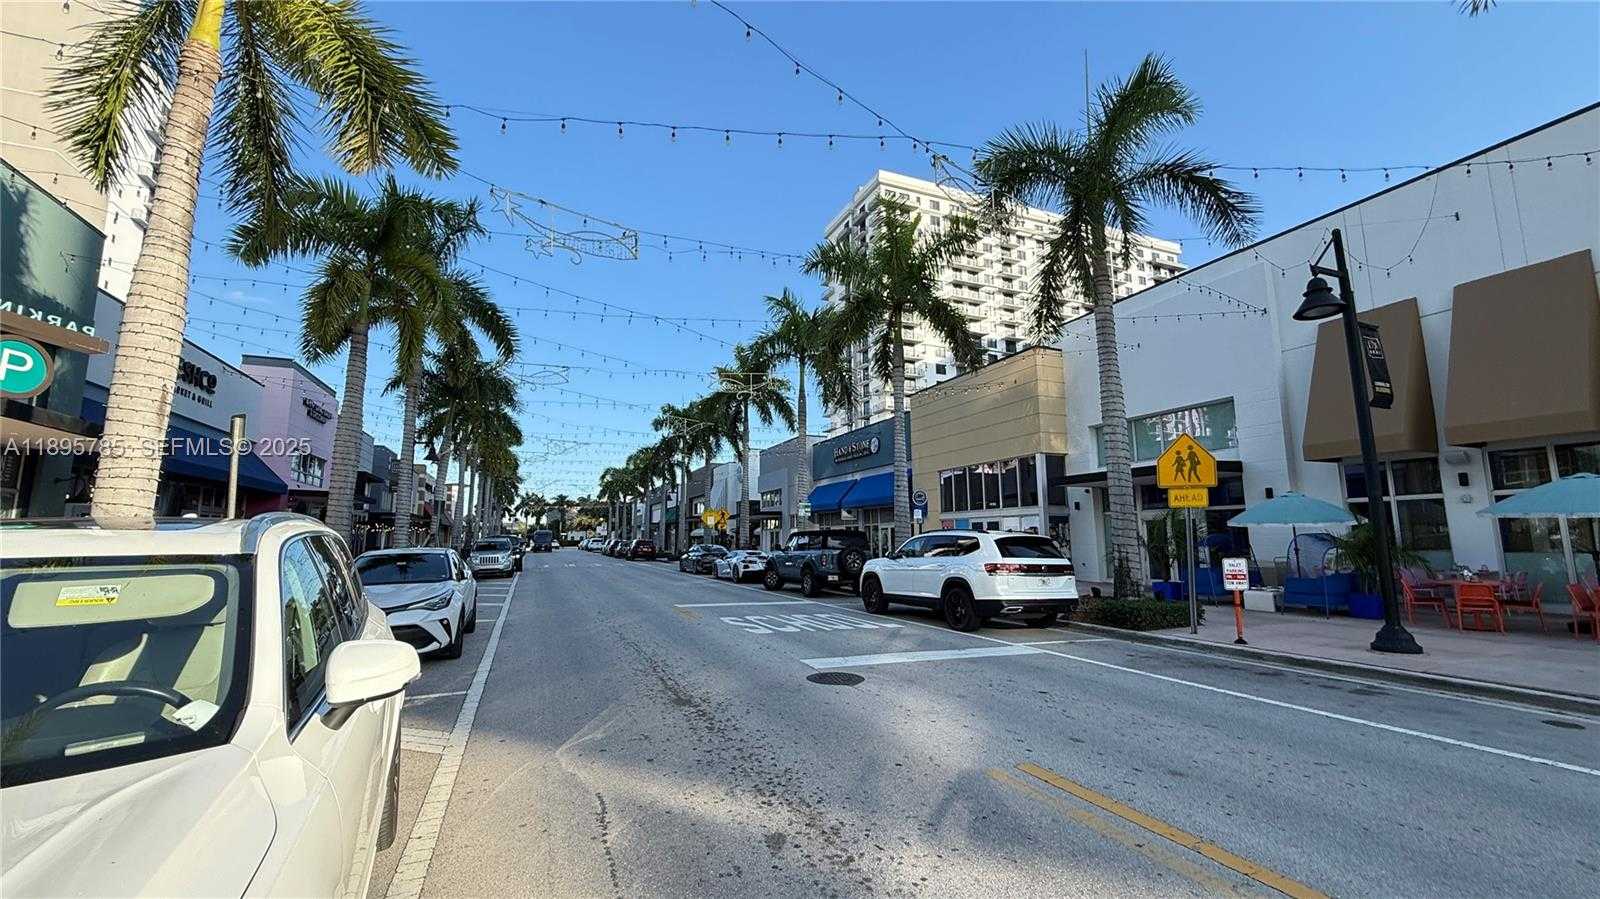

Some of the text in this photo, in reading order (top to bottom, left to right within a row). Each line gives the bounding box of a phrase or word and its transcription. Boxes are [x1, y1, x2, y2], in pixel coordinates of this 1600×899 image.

[0, 347, 34, 381] P
[1173, 492, 1204, 503] AHEAD
[720, 613, 905, 634] SCHOOL
